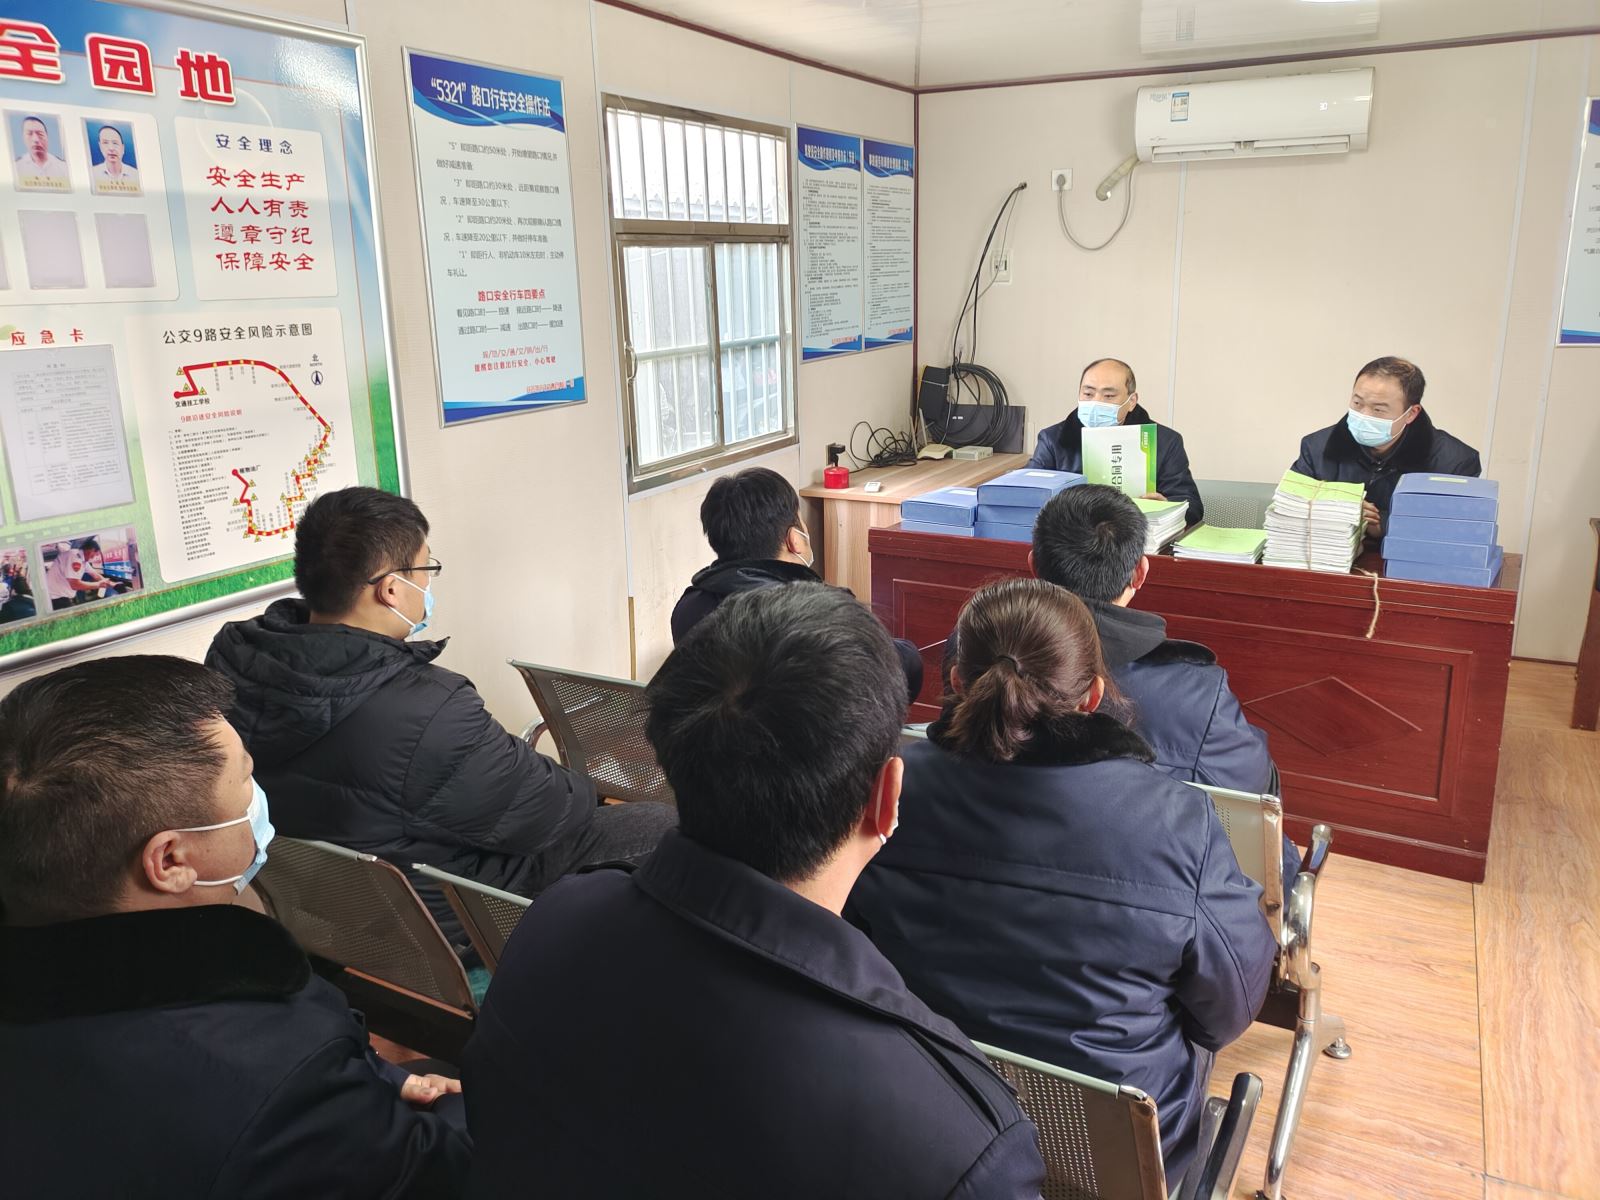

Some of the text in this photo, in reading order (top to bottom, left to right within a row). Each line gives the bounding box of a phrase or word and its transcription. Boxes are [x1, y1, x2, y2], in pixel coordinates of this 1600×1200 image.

[0, 20, 236, 104] 全园地
[215, 133, 294, 156] 安全理念
[206, 166, 305, 191] 安全生产
[210, 196, 310, 219] 人人有责
[213, 223, 314, 245] 遵章守纪
[215, 252, 315, 272] 保障安全
[478, 288, 546, 302] 路口安全行车四要点
[11, 328, 86, 346] 应急卡
[163, 322, 313, 344] 公交9路安全风险示意图
[1111, 444, 1123, 493] 合同专用
